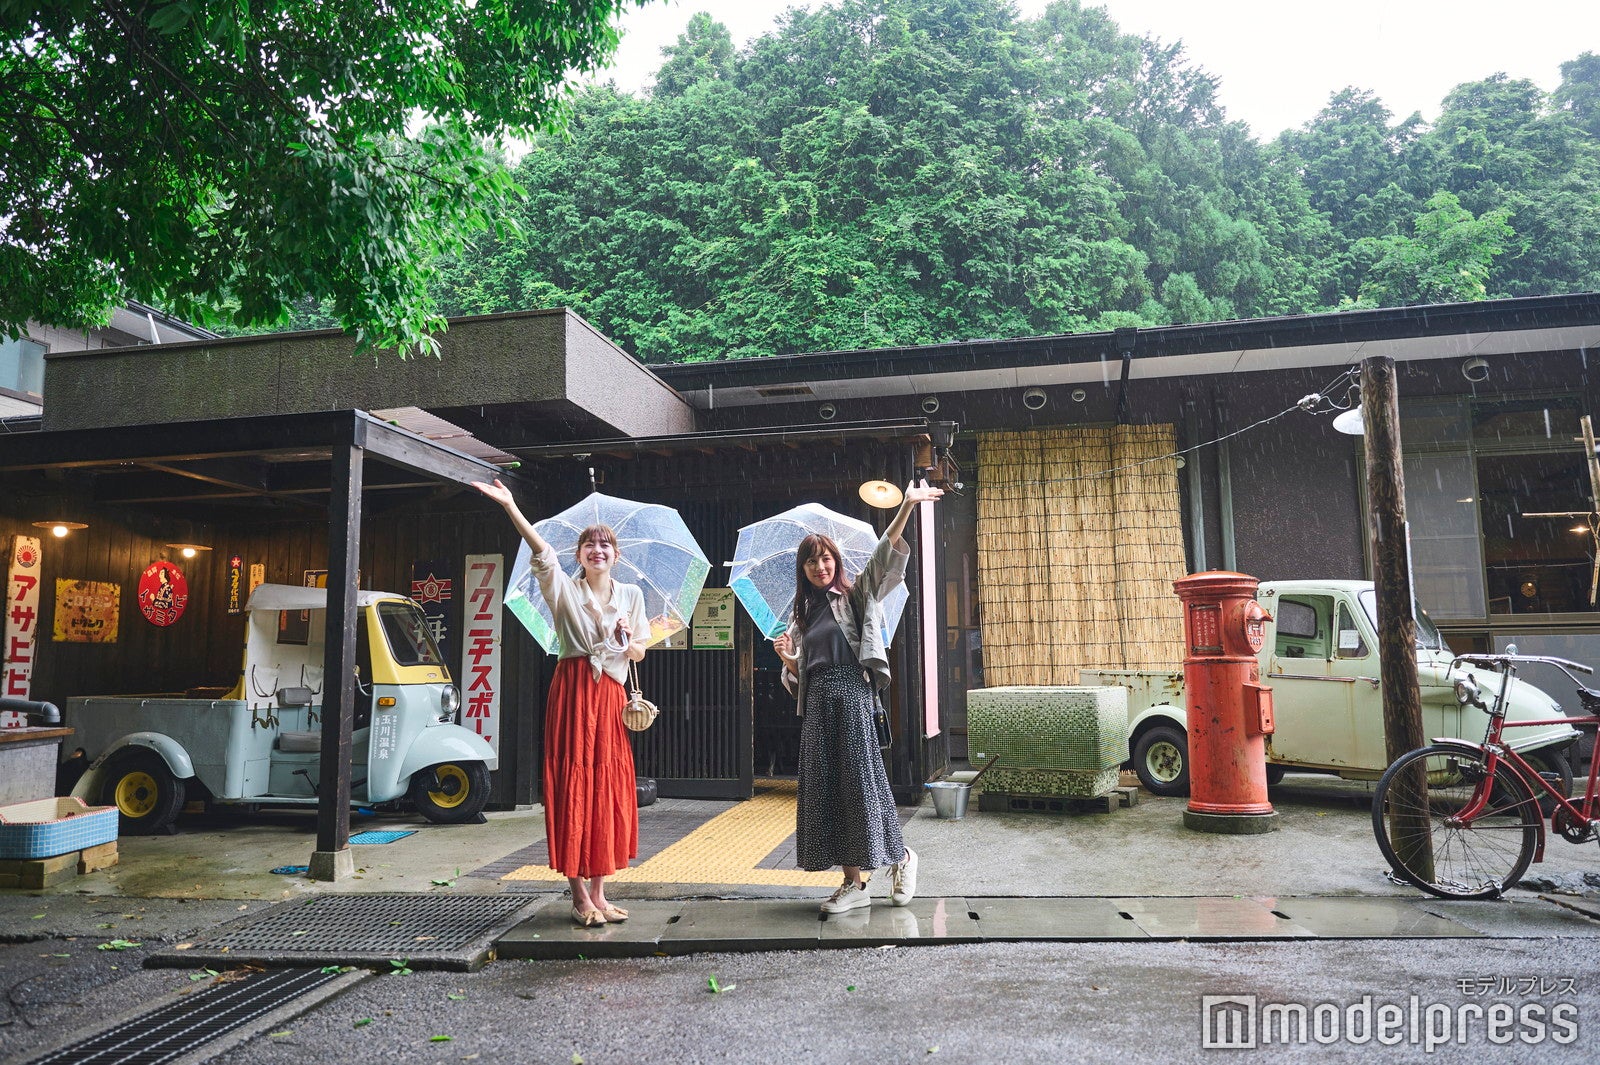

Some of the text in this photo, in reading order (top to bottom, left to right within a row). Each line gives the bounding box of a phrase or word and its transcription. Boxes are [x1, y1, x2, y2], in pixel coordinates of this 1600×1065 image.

[8, 574, 38, 726] アサヒビ
[466, 563, 496, 742] フクニチスポー
[379, 714, 391, 759] 玉川温泉
